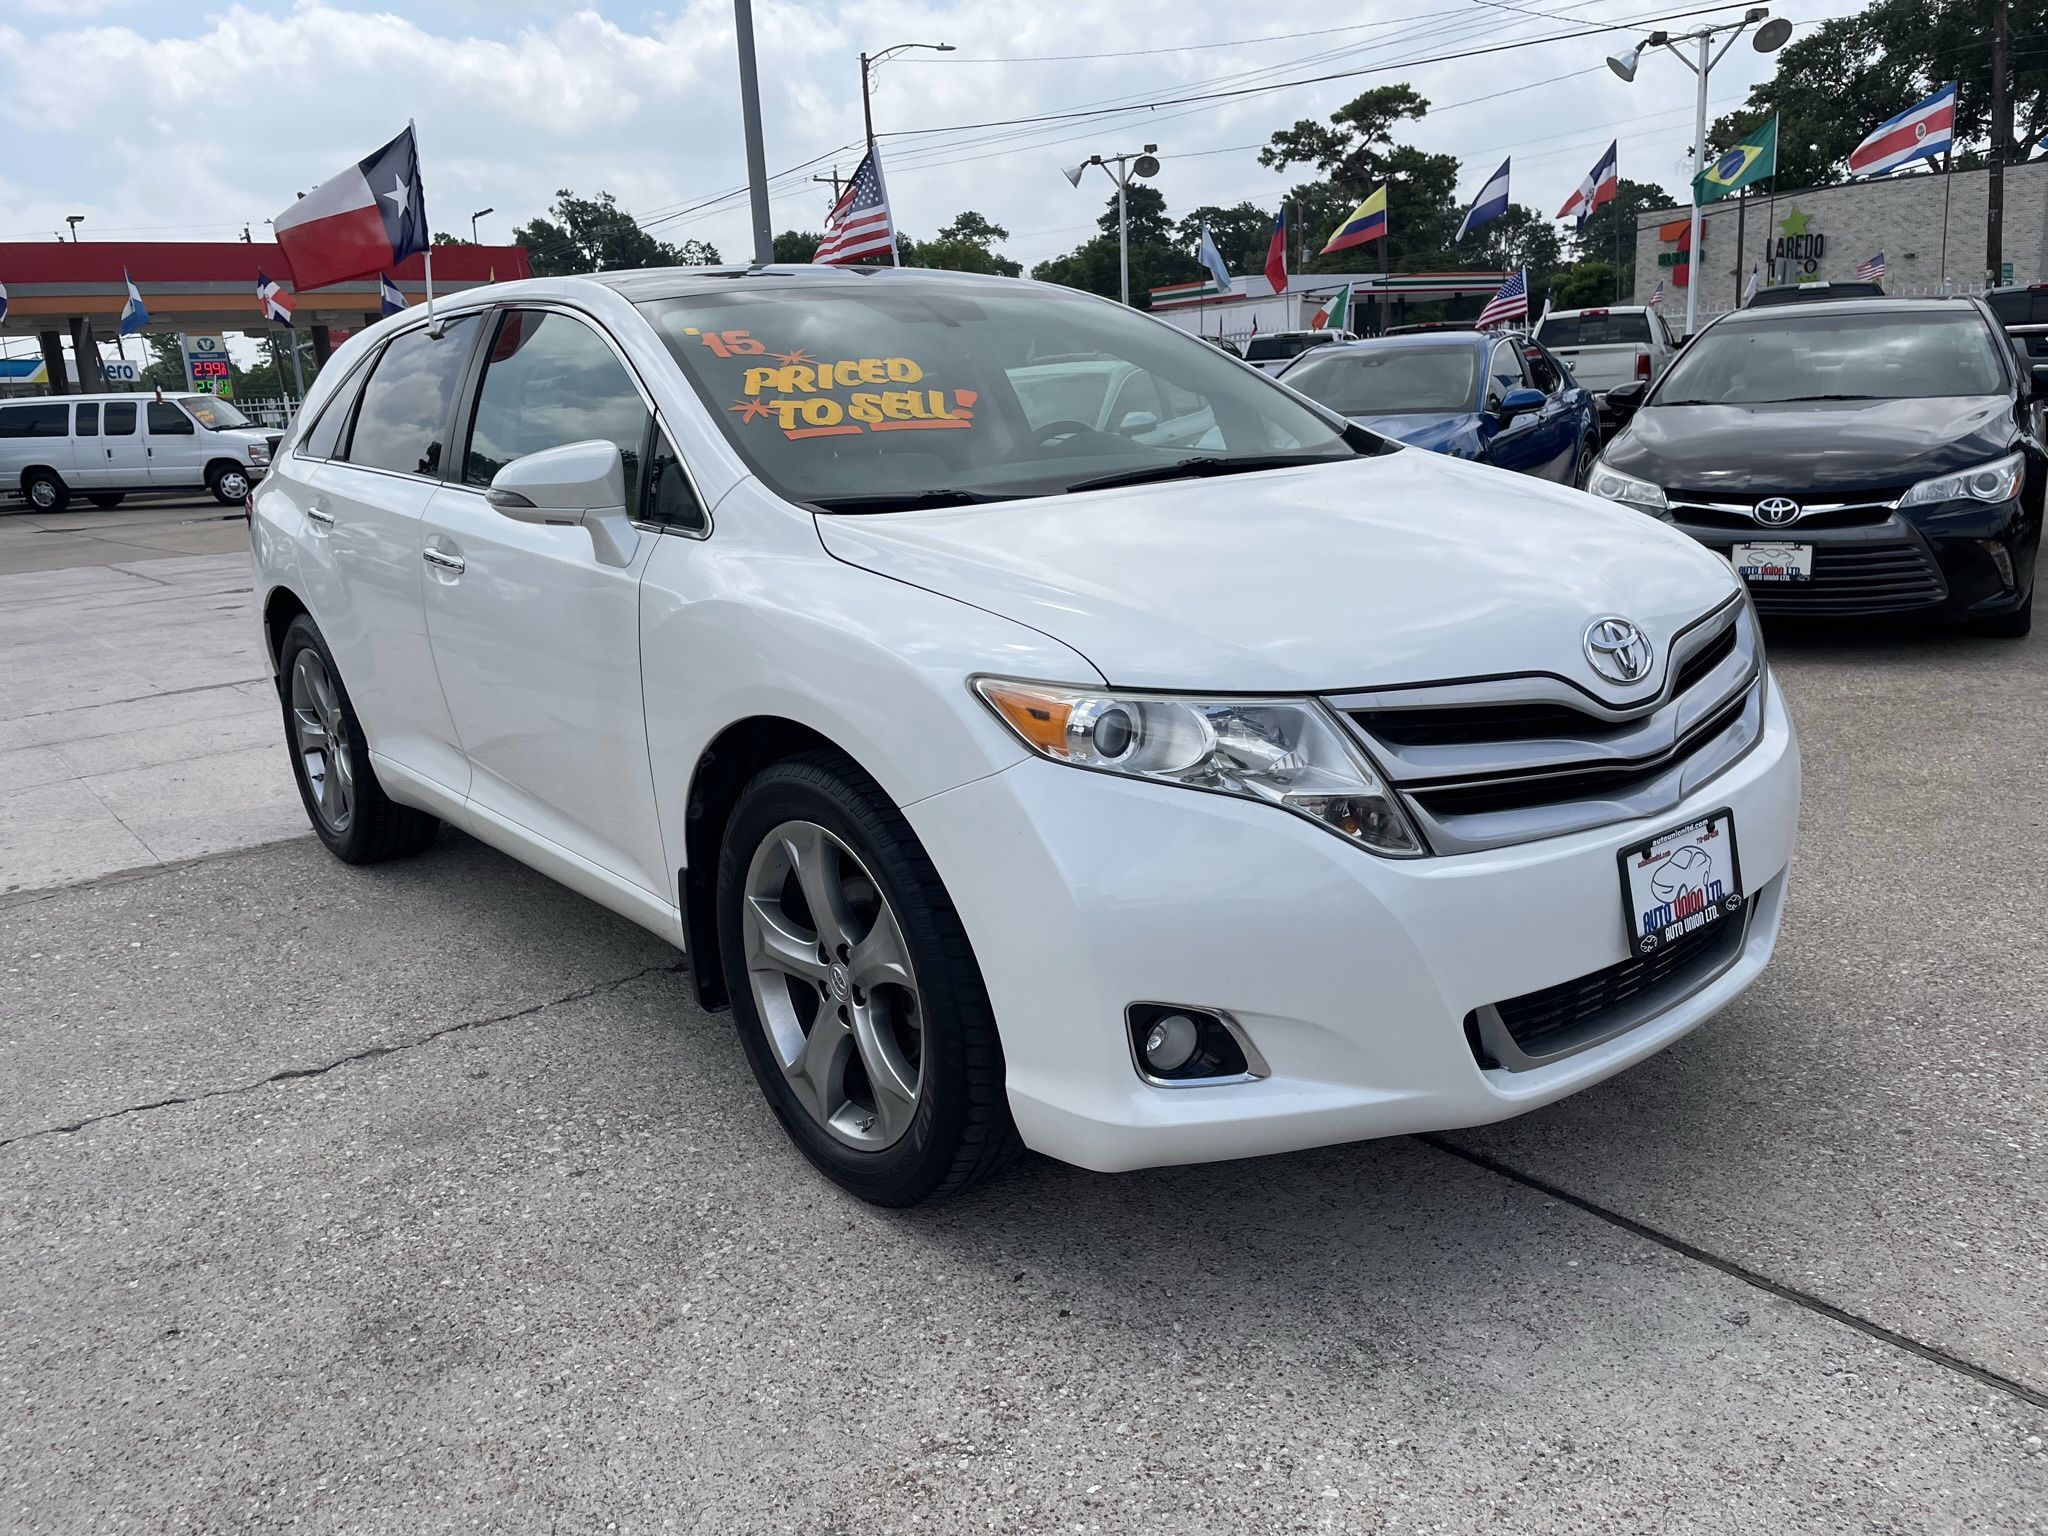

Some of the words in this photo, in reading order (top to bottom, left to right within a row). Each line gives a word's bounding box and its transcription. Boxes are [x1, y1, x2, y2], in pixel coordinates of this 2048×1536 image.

[1766, 233, 1825, 262] LAREDO
[1768, 258, 1818, 278] TO
[743, 358, 923, 396] PRICED
[769, 397, 844, 430] TO
[848, 389, 978, 424] SELL!
[1738, 566, 1759, 575] AUTO
[1652, 819, 1709, 847] autounionltd.com
[1642, 902, 1673, 935] AUTO
[1664, 921, 1684, 943] AUTO
[1704, 904, 1720, 923] LTD.
